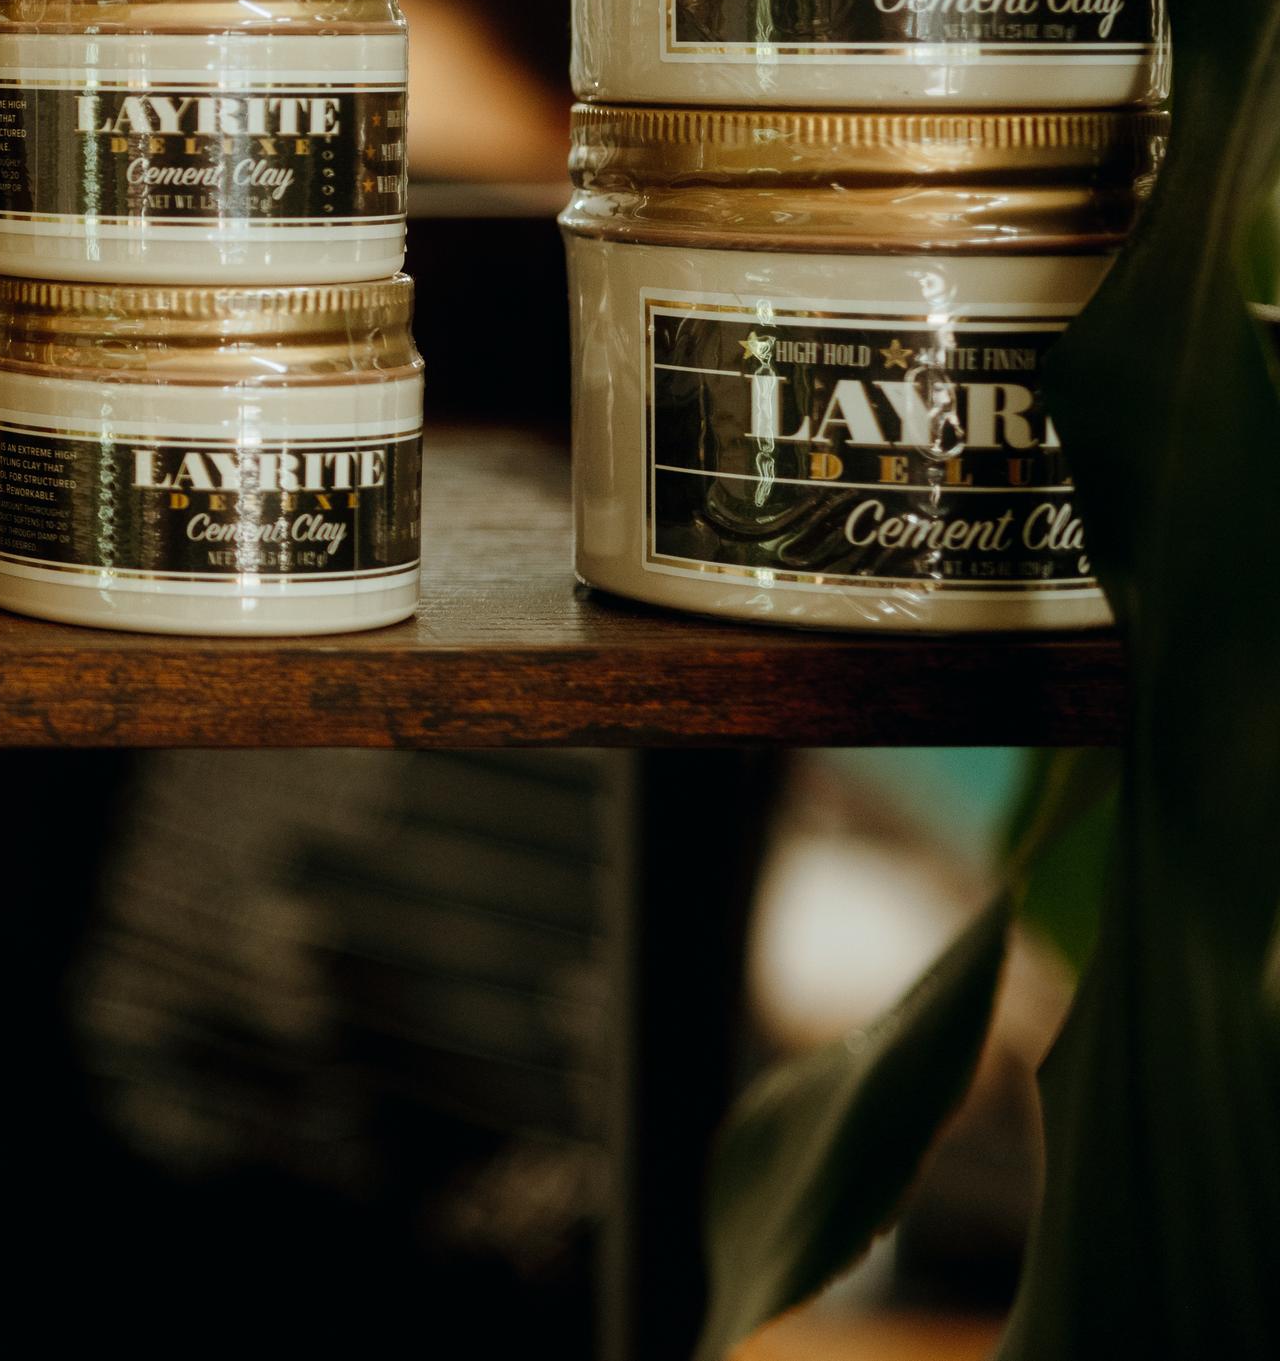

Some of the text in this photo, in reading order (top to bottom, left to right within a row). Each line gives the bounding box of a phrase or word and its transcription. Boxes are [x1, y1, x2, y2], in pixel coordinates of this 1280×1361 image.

[8, 100, 27, 110] HIGH
[74, 95, 341, 137] LAYRITE
[0, 114, 16, 123] THAT
[125, 157, 295, 201] Cement Clay
[147, 194, 170, 209] NET
[775, 340, 818, 364] HIGH
[823, 343, 871, 368] HOLD
[982, 348, 1037, 371] FINISH
[7, 442, 17, 452] AN
[18, 444, 52, 458] EXTREME
[54, 450, 78, 460] HIGH
[22, 459, 42, 471] CLAY
[43, 463, 65, 473] THAT
[130, 449, 385, 491] LAYRITE
[809, 452, 1072, 486] DELU
[9, 471, 22, 481] FOR
[23, 474, 78, 489] STRUCTURED
[169, 492, 360, 511] DEUXE
[186, 512, 347, 556] Cemnt Clay
[844, 498, 1014, 550] Cement
